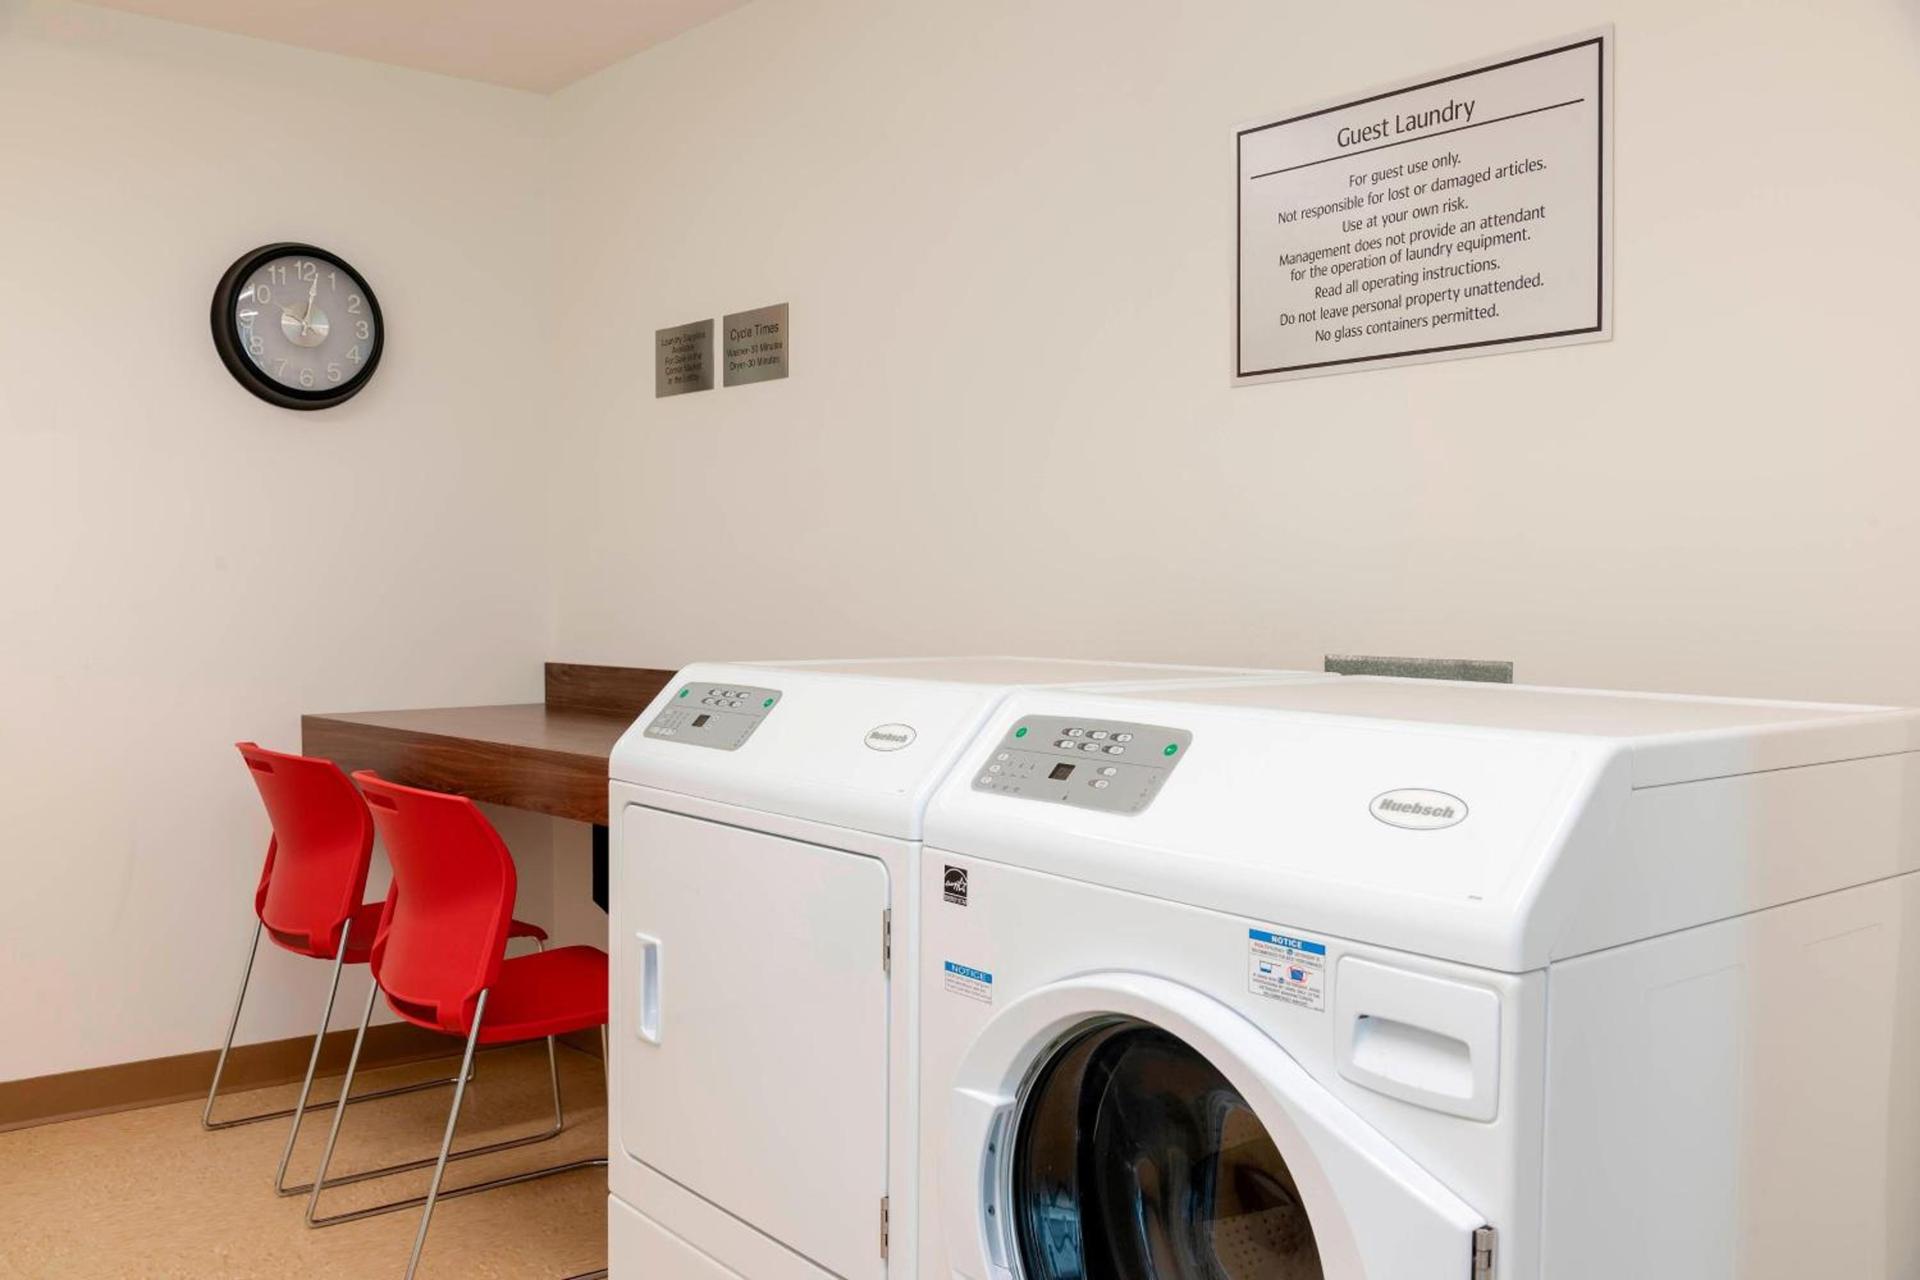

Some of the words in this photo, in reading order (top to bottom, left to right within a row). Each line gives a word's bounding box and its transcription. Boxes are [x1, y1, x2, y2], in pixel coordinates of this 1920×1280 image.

[1337, 119, 1389, 147] Guest
[1396, 99, 1475, 134] Laundry
[1350, 174, 1367, 187] For
[1371, 165, 1403, 185] guest
[1407, 161, 1428, 174] use
[1432, 152, 1461, 169] only.
[1278, 210, 1297, 224] Not
[1301, 196, 1364, 219] responsible
[1368, 192, 1384, 205] for
[1388, 186, 1410, 201] lost
[1414, 184, 1427, 195] or
[1431, 167, 1491, 192] damaged
[1495, 158, 1547, 179] articles.
[1342, 220, 1363, 232] Use
[1366, 215, 1377, 228] at
[1382, 210, 1408, 228] your
[1412, 204, 1439, 219] own
[1443, 197, 1468, 213] risk.
[1279, 243, 1351, 266] Management
[1354, 238, 1382, 253] does
[1386, 233, 1406, 246] not
[1410, 222, 1456, 245] provide
[1460, 221, 1475, 233] an
[1480, 206, 1545, 230] attendant
[1291, 268, 1306, 281] for
[1310, 265, 1328, 278] the
[1331, 255, 1386, 276] operation
[1390, 249, 1402, 264] of
[1406, 242, 1453, 261] laundry
[1456, 228, 1530, 253] equipment.
[268, 265, 286, 285] 11
[293, 260, 316, 281] 12
[1315, 282, 1342, 299] Read
[1346, 280, 1358, 293] all
[1362, 271, 1419, 292] operating
[1423, 259, 1500, 281] instructions.
[328, 272, 336, 291] 1
[250, 283, 271, 304] 10
[1280, 313, 1295, 326] Do
[1298, 310, 1316, 323] not
[1320, 307, 1348, 320] leave
[1352, 295, 1402, 318] personal
[1406, 288, 1460, 310] property
[1464, 272, 1544, 298] unattended.
[347, 294, 360, 314] 2
[356, 320, 369, 340] 3
[730, 327, 753, 342] Cycle
[754, 322, 779, 336] Times
[1315, 330, 1331, 342] No
[1334, 325, 1363, 342] glass
[1366, 317, 1428, 335] containers
[1432, 303, 1499, 328] permitted.
[251, 336, 264, 355] 8
[346, 345, 362, 364] 4
[276, 358, 288, 377] 7
[300, 367, 314, 387] 6
[327, 362, 341, 382] 5
[1378, 797, 1456, 820] Huebsch
[1271, 935, 1303, 949] NOTICE
[951, 964, 985, 981] NOTICE
